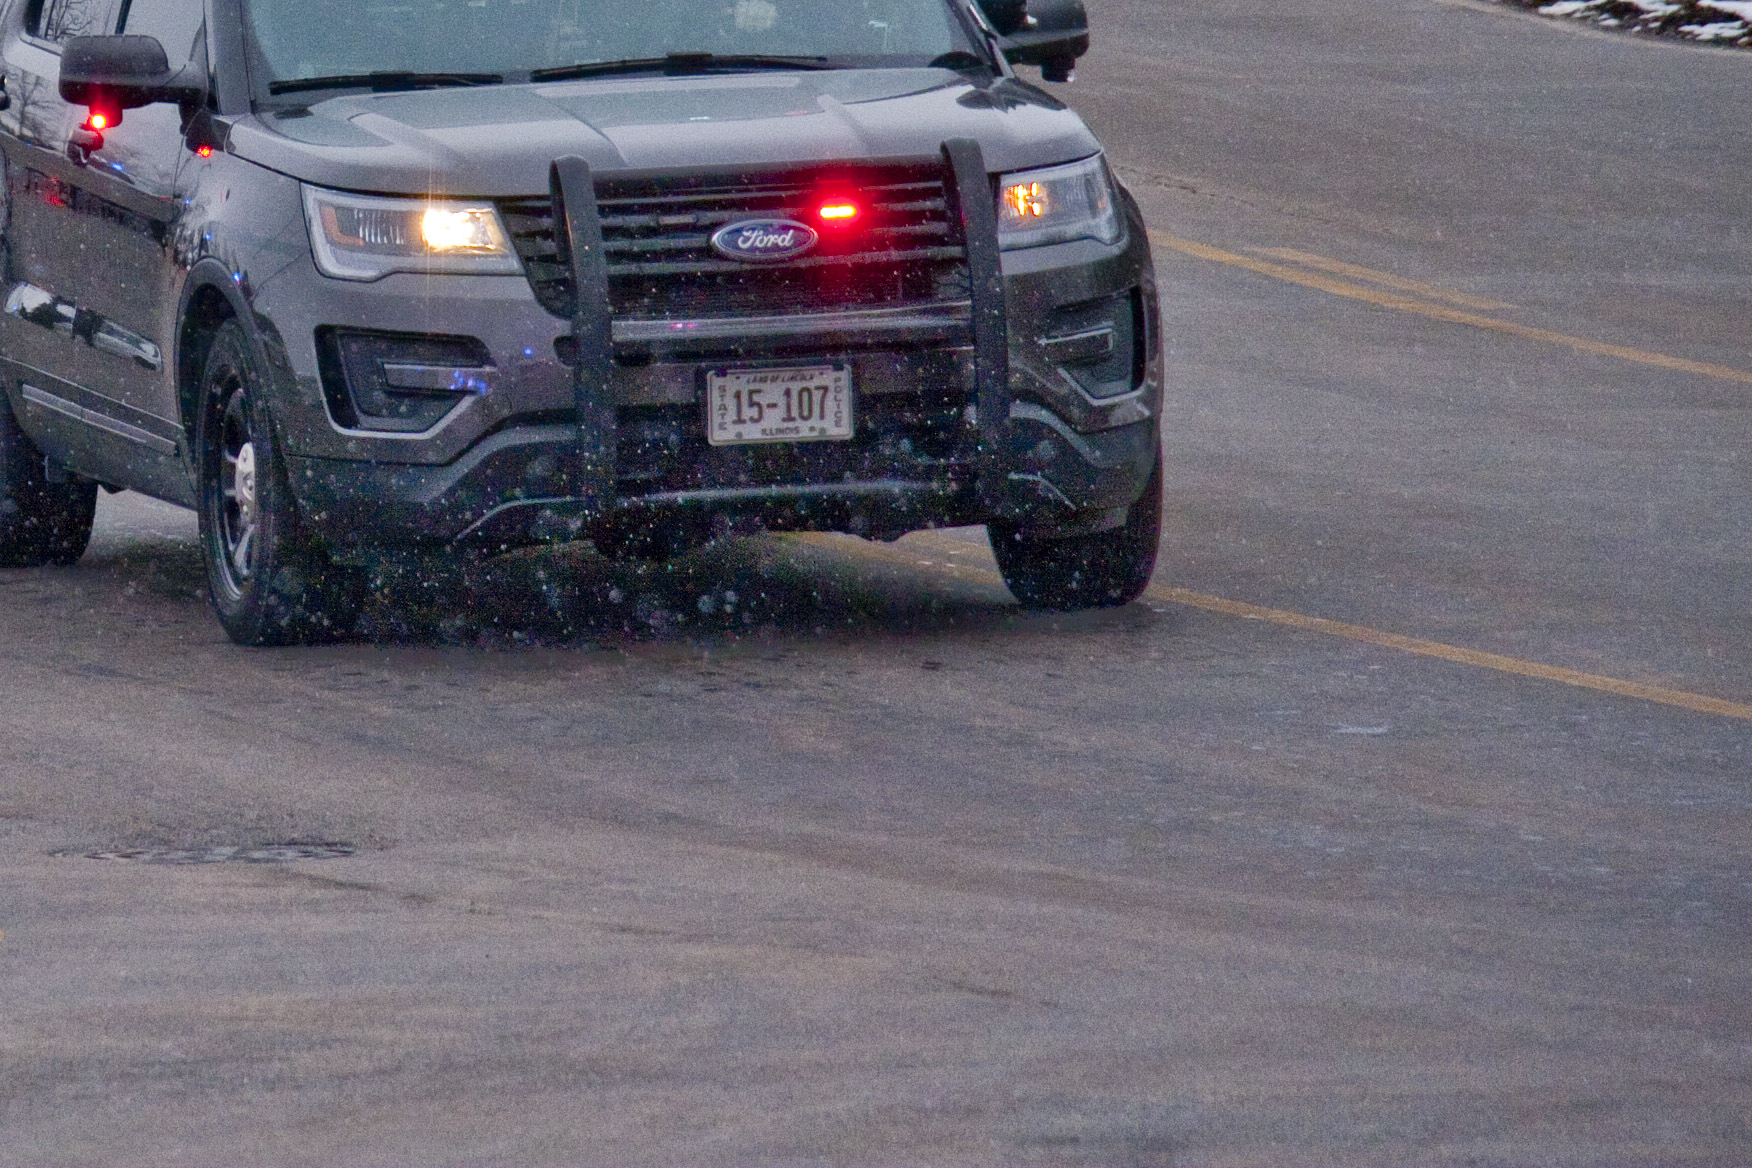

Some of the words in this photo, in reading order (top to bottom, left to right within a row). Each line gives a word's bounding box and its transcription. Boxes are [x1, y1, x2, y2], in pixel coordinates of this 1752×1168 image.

[737, 228, 794, 249] Ford
[718, 385, 727, 431] STATE
[732, 385, 830, 425] 15-107
[834, 377, 843, 428] POLICE
